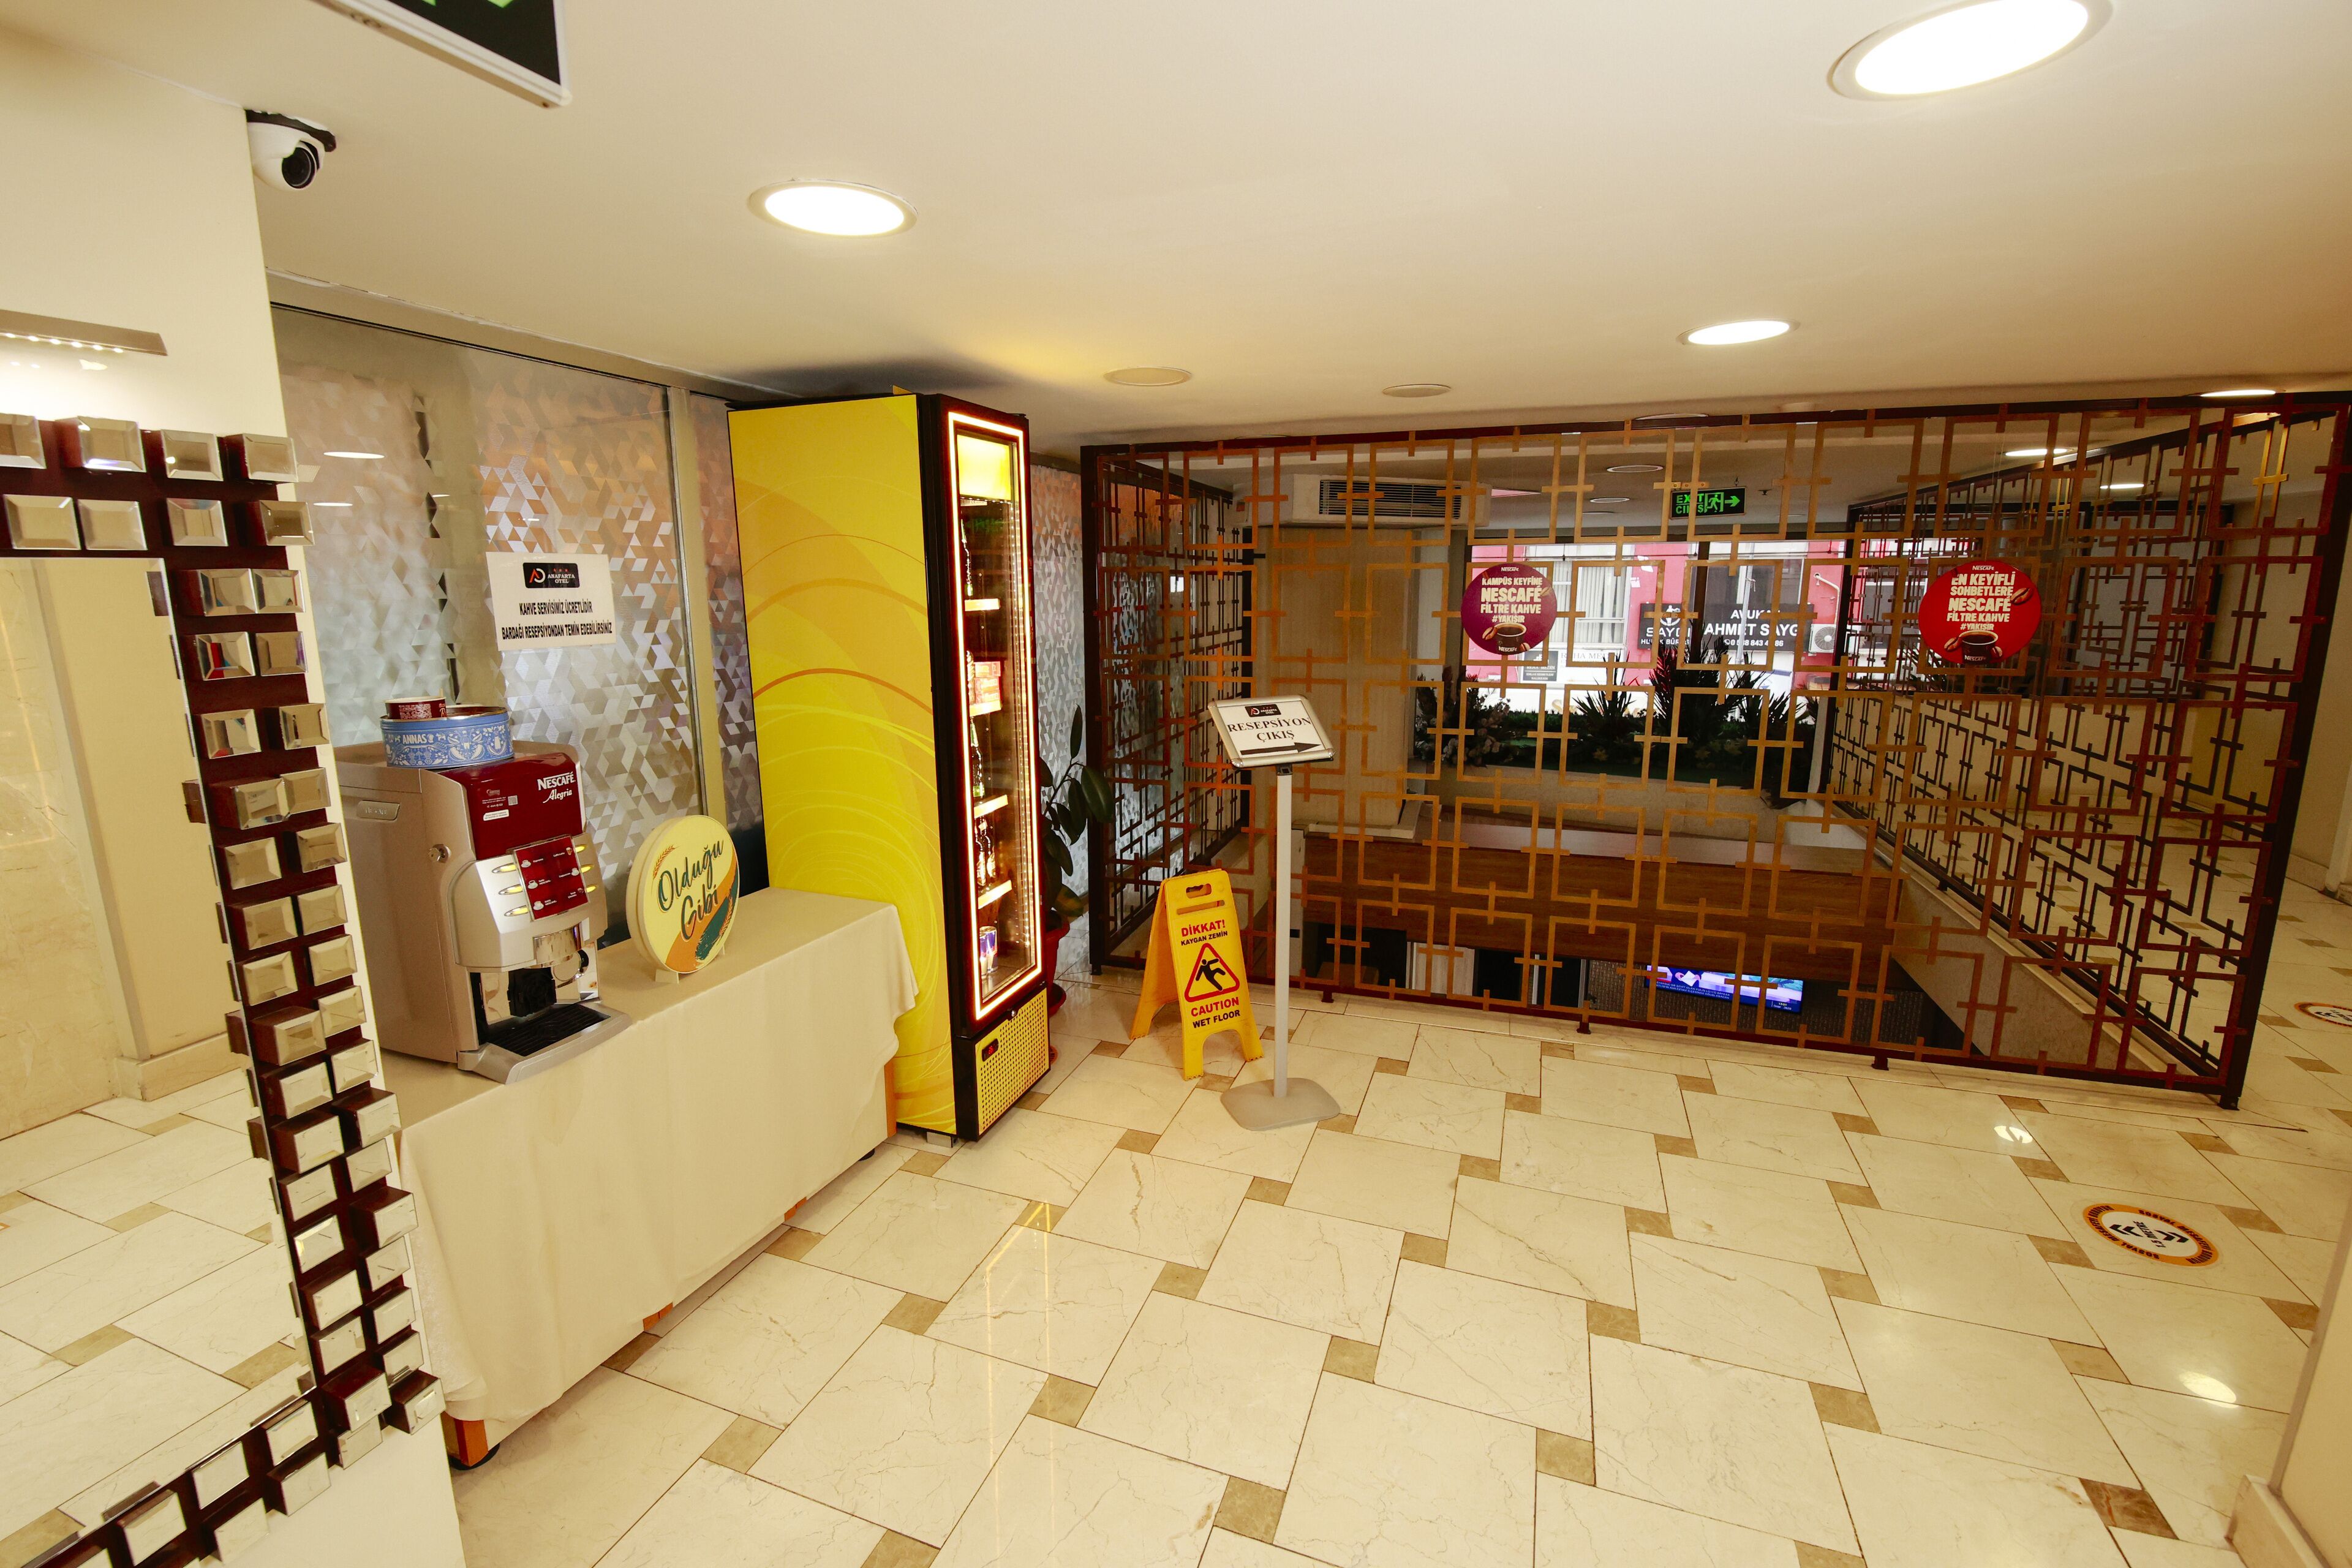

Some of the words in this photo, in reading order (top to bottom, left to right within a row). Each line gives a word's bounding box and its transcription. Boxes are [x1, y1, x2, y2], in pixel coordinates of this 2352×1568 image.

[1676, 493, 1704, 503] EXT
[1482, 576, 1513, 586] KAMPÜS
[1513, 576, 1543, 586] KEYFİNE
[1970, 571, 2016, 586] KEYİFLİ
[1481, 586, 1542, 602] NESCAFÉ
[1950, 586, 2014, 596] SOHBETLERE
[519, 603, 537, 616] KAHVE
[537, 599, 565, 614] SERVİSİMİZ
[565, 598, 593, 614] ÜCRETLİDİR
[1480, 602, 1509, 614] FİLTRE
[1510, 604, 1542, 614] KAHVE
[1948, 596, 2011, 612] NESCAFÉ
[1947, 611, 1977, 622] FİLTRE
[1978, 613, 2010, 622] KAHVE
[502, 624, 524, 640] BARDAĞI
[525, 622, 565, 639] RESEPSİYONDAN
[565, 620, 580, 636] TEMİN
[581, 620, 612, 635] EDEBİLİRSİNİZ
[1227, 717, 1312, 733] RESEPSİYON
[403, 734, 428, 744] ANNAS
[1257, 729, 1295, 743] ÇIKIŞ
[537, 771, 575, 791] NESCAFÉ
[543, 788, 573, 804] Alegria
[658, 840, 724, 911] Olduğu
[681, 884, 718, 940] Gibi
[1181, 919, 1226, 937] DİKKAT!
[1180, 934, 1207, 946] KAYGAN
[1208, 930, 1228, 941] ZEMİN
[1191, 997, 1240, 1017] CAUTION
[1192, 1017, 1211, 1028] WET
[1213, 1009, 1241, 1023] FLOOR
[2132, 1220, 2158, 1239] METRE
